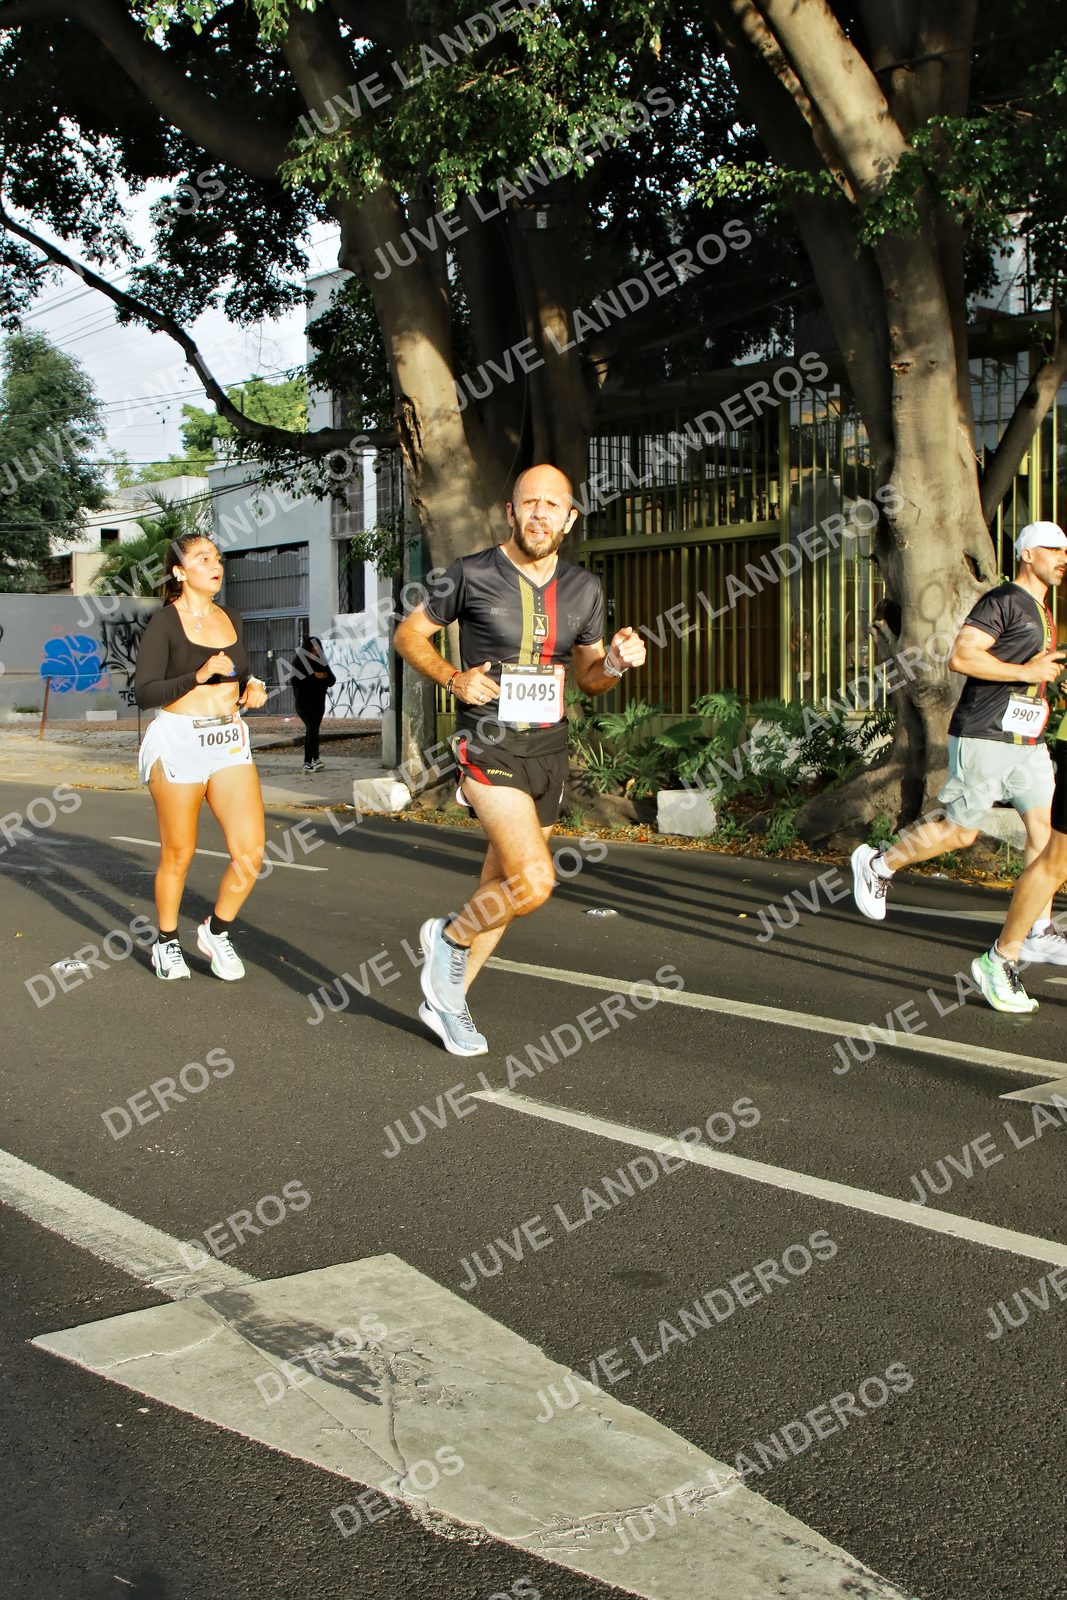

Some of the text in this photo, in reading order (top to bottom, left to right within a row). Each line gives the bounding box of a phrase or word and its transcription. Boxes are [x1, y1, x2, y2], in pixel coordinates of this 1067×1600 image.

[505, 682, 556, 701] 10495
[1011, 707, 1040, 722] 9907
[198, 728, 239, 747] 10058
